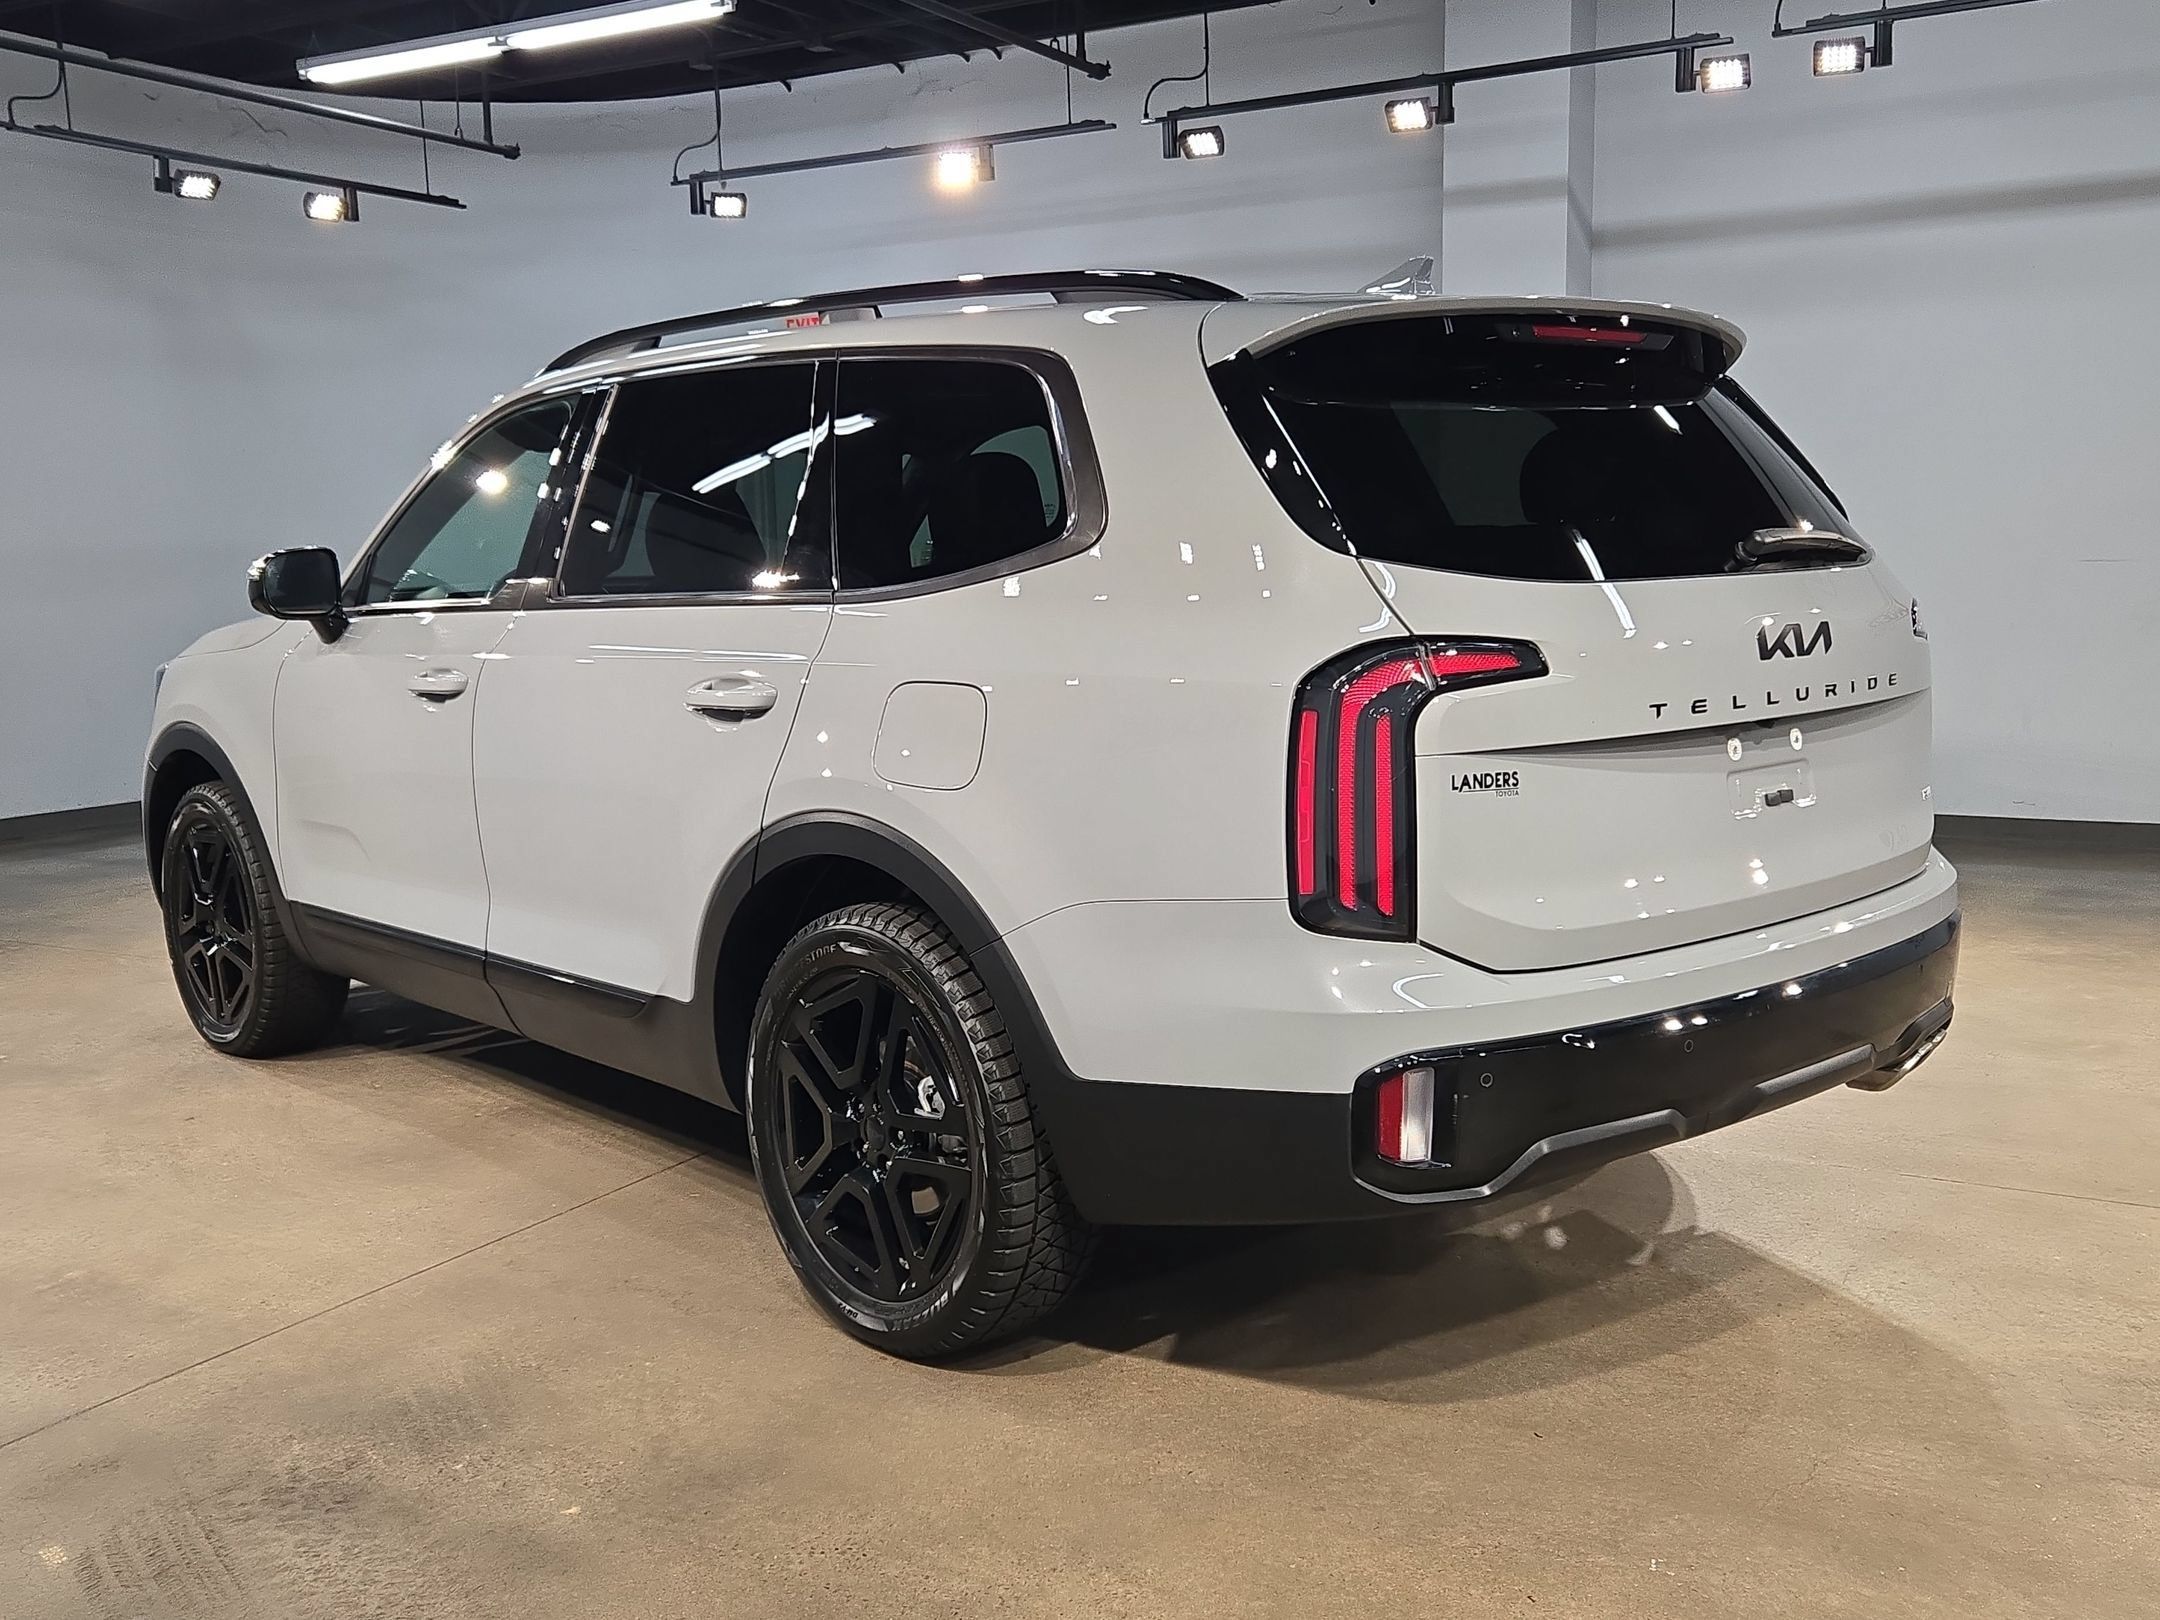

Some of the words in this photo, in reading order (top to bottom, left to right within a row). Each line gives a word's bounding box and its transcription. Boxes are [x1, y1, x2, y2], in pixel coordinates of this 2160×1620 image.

[1756, 621, 1832, 660] KIA
[1649, 672, 1898, 719] TELLURIDE
[1451, 771, 1519, 792] LANDERS
[1495, 790, 1520, 798] TOYOTA
